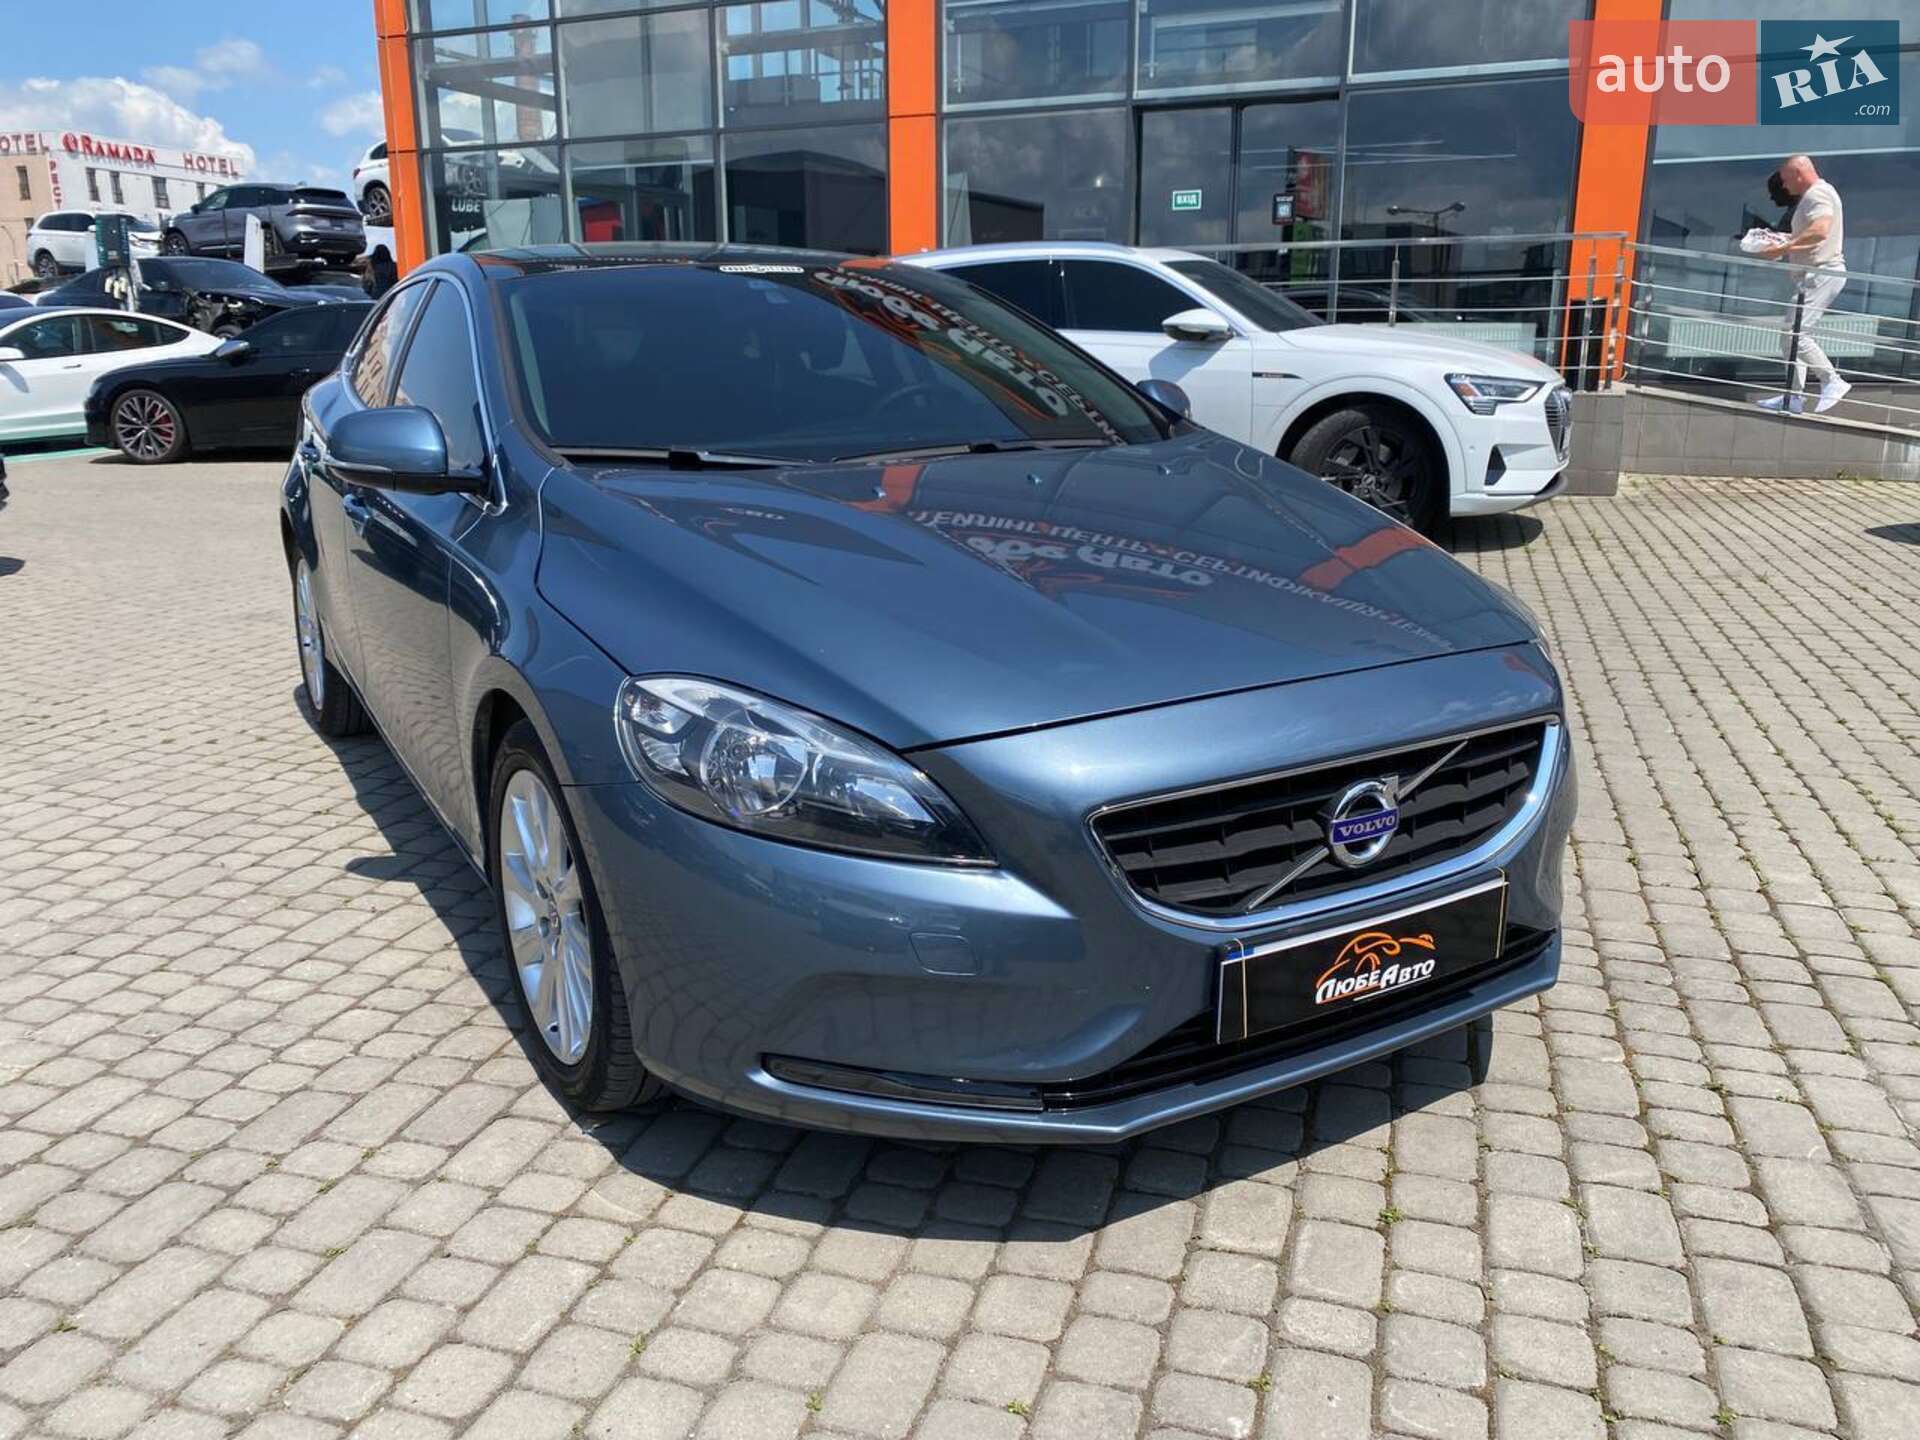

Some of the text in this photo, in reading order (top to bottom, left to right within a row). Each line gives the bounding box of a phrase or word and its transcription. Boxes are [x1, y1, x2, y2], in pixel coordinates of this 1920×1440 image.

[80, 134, 239, 177] RAMADA HOTEL
[1338, 814, 1396, 838] VOLVO
